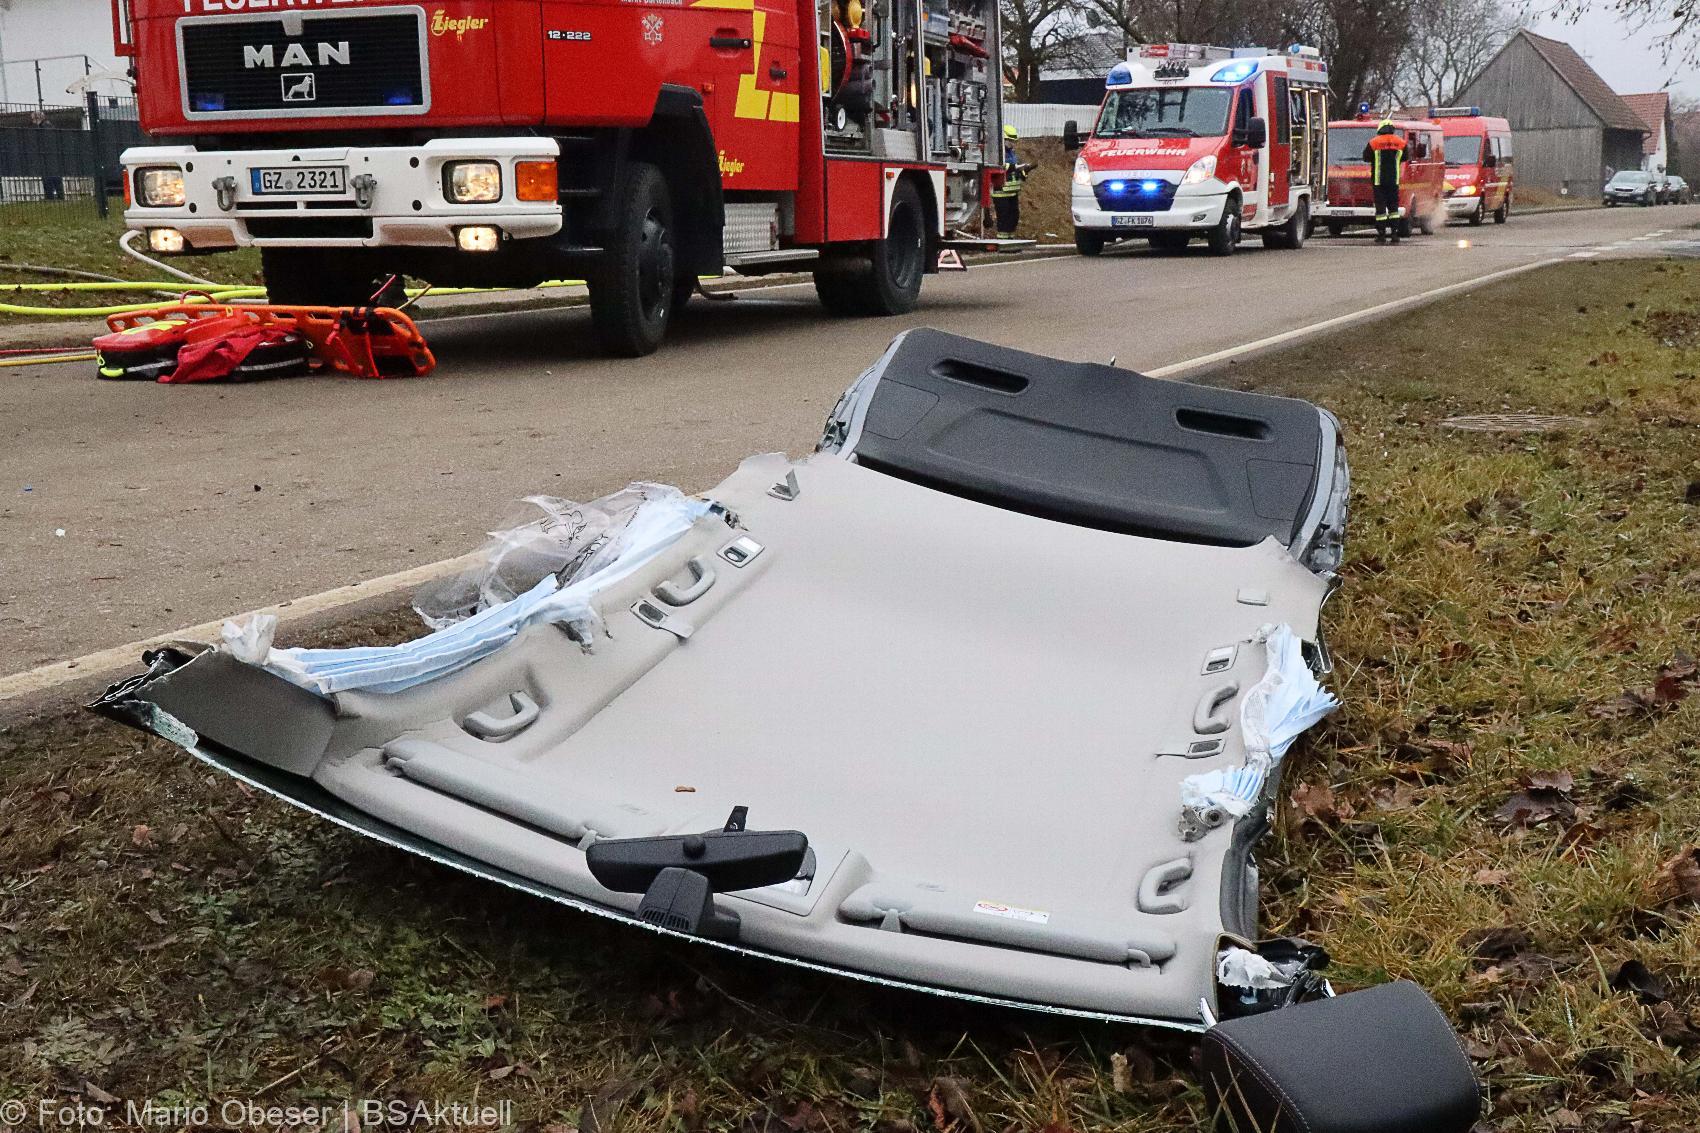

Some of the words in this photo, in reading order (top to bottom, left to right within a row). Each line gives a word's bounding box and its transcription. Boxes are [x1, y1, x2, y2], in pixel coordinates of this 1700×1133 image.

[431, 9, 489, 36] Ziegler
[243, 41, 350, 68] MAN
[1100, 148, 1187, 157] FEUERWEHR
[262, 171, 284, 190] GZ
[296, 170, 339, 189] 2321
